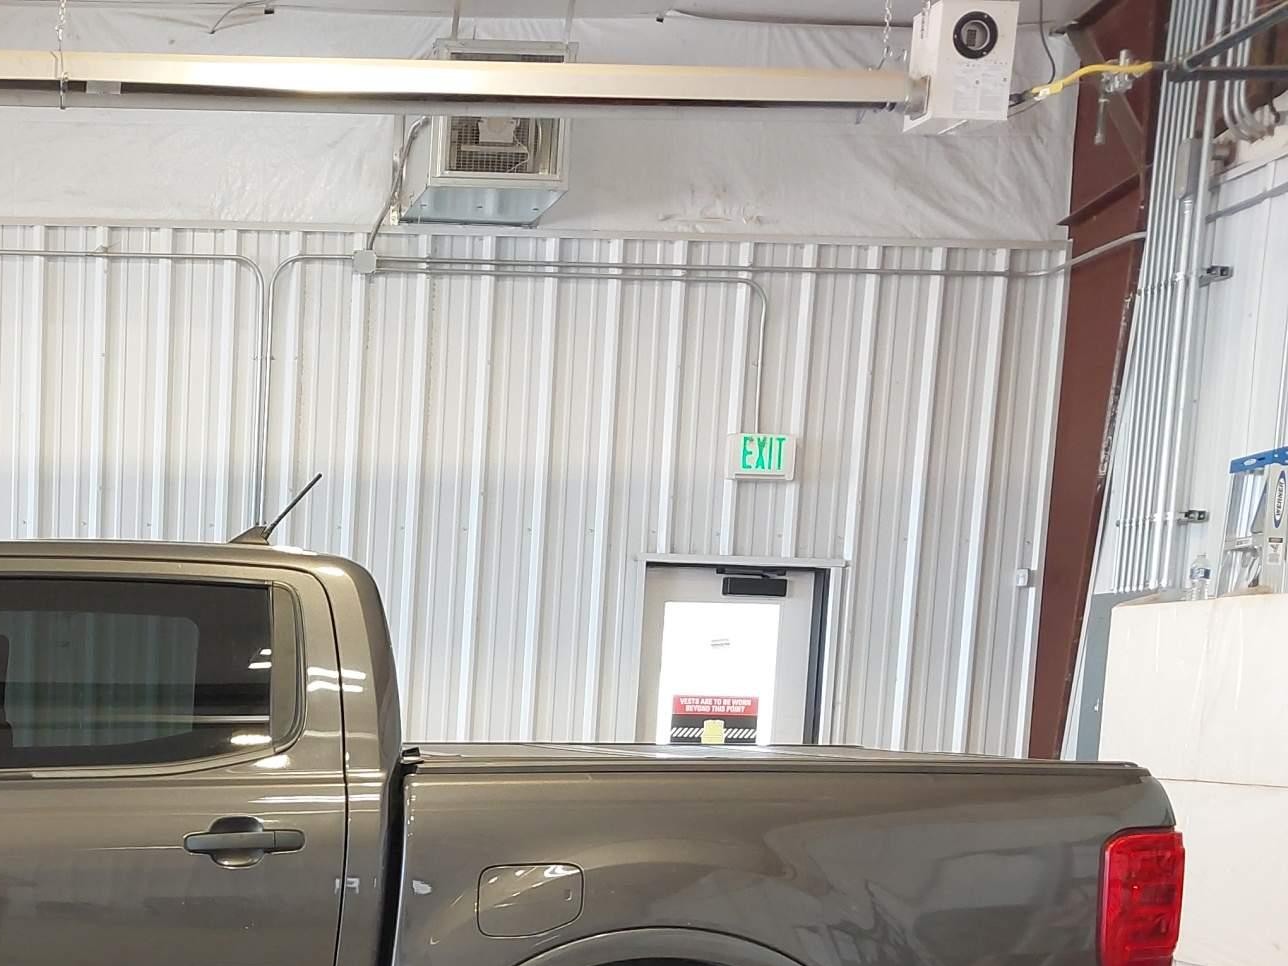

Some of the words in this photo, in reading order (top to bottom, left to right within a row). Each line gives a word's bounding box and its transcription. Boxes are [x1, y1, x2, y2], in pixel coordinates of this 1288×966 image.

[742, 436, 786, 470] EXIT
[1275, 481, 1284, 516] WERNER
[679, 697, 700, 705] VESTS
[722, 698, 732, 706] BE
[712, 705, 725, 713] THIS
[726, 705, 746, 713] POINT
